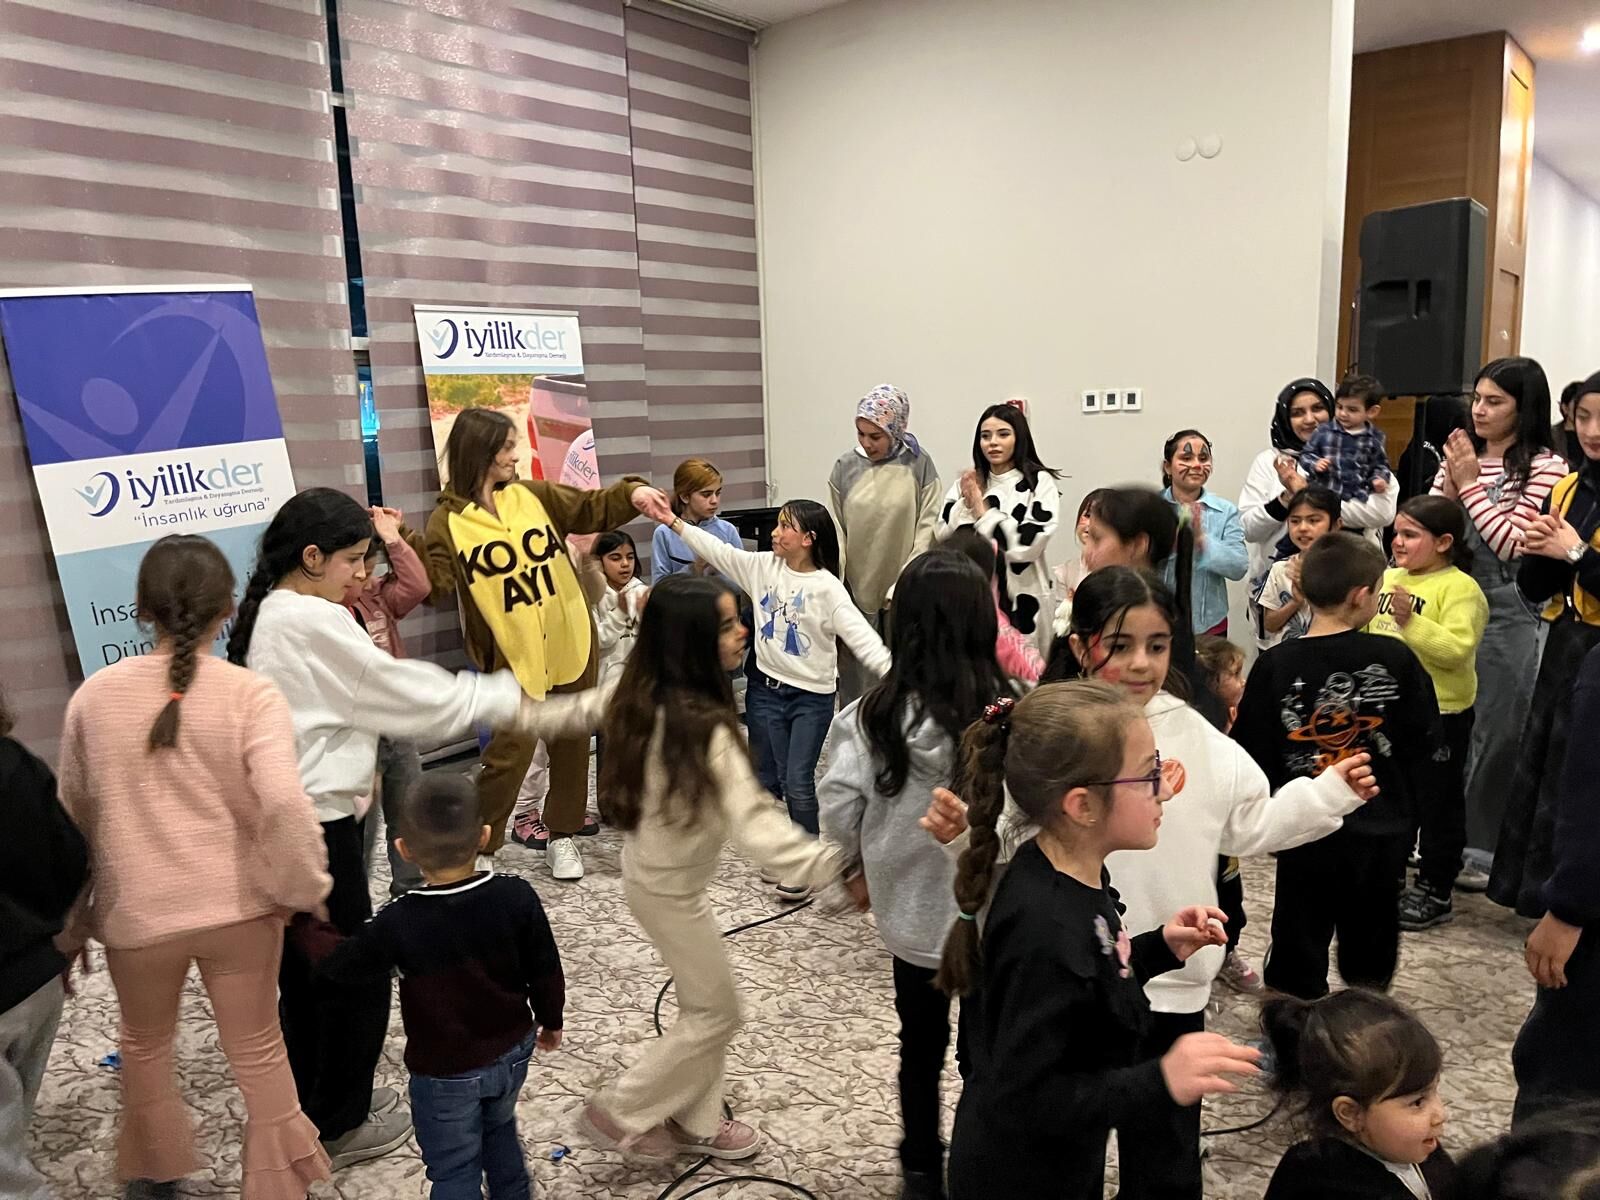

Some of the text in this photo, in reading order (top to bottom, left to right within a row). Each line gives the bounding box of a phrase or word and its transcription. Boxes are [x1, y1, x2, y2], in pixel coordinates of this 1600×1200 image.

[464, 320, 566, 357] iyilikder
[126, 458, 264, 508] iyilikder
[503, 564, 556, 613] AYI
[1377, 592, 1426, 616] OON
[90, 601, 139, 626] İnsa
[102, 639, 154, 666] Dün
